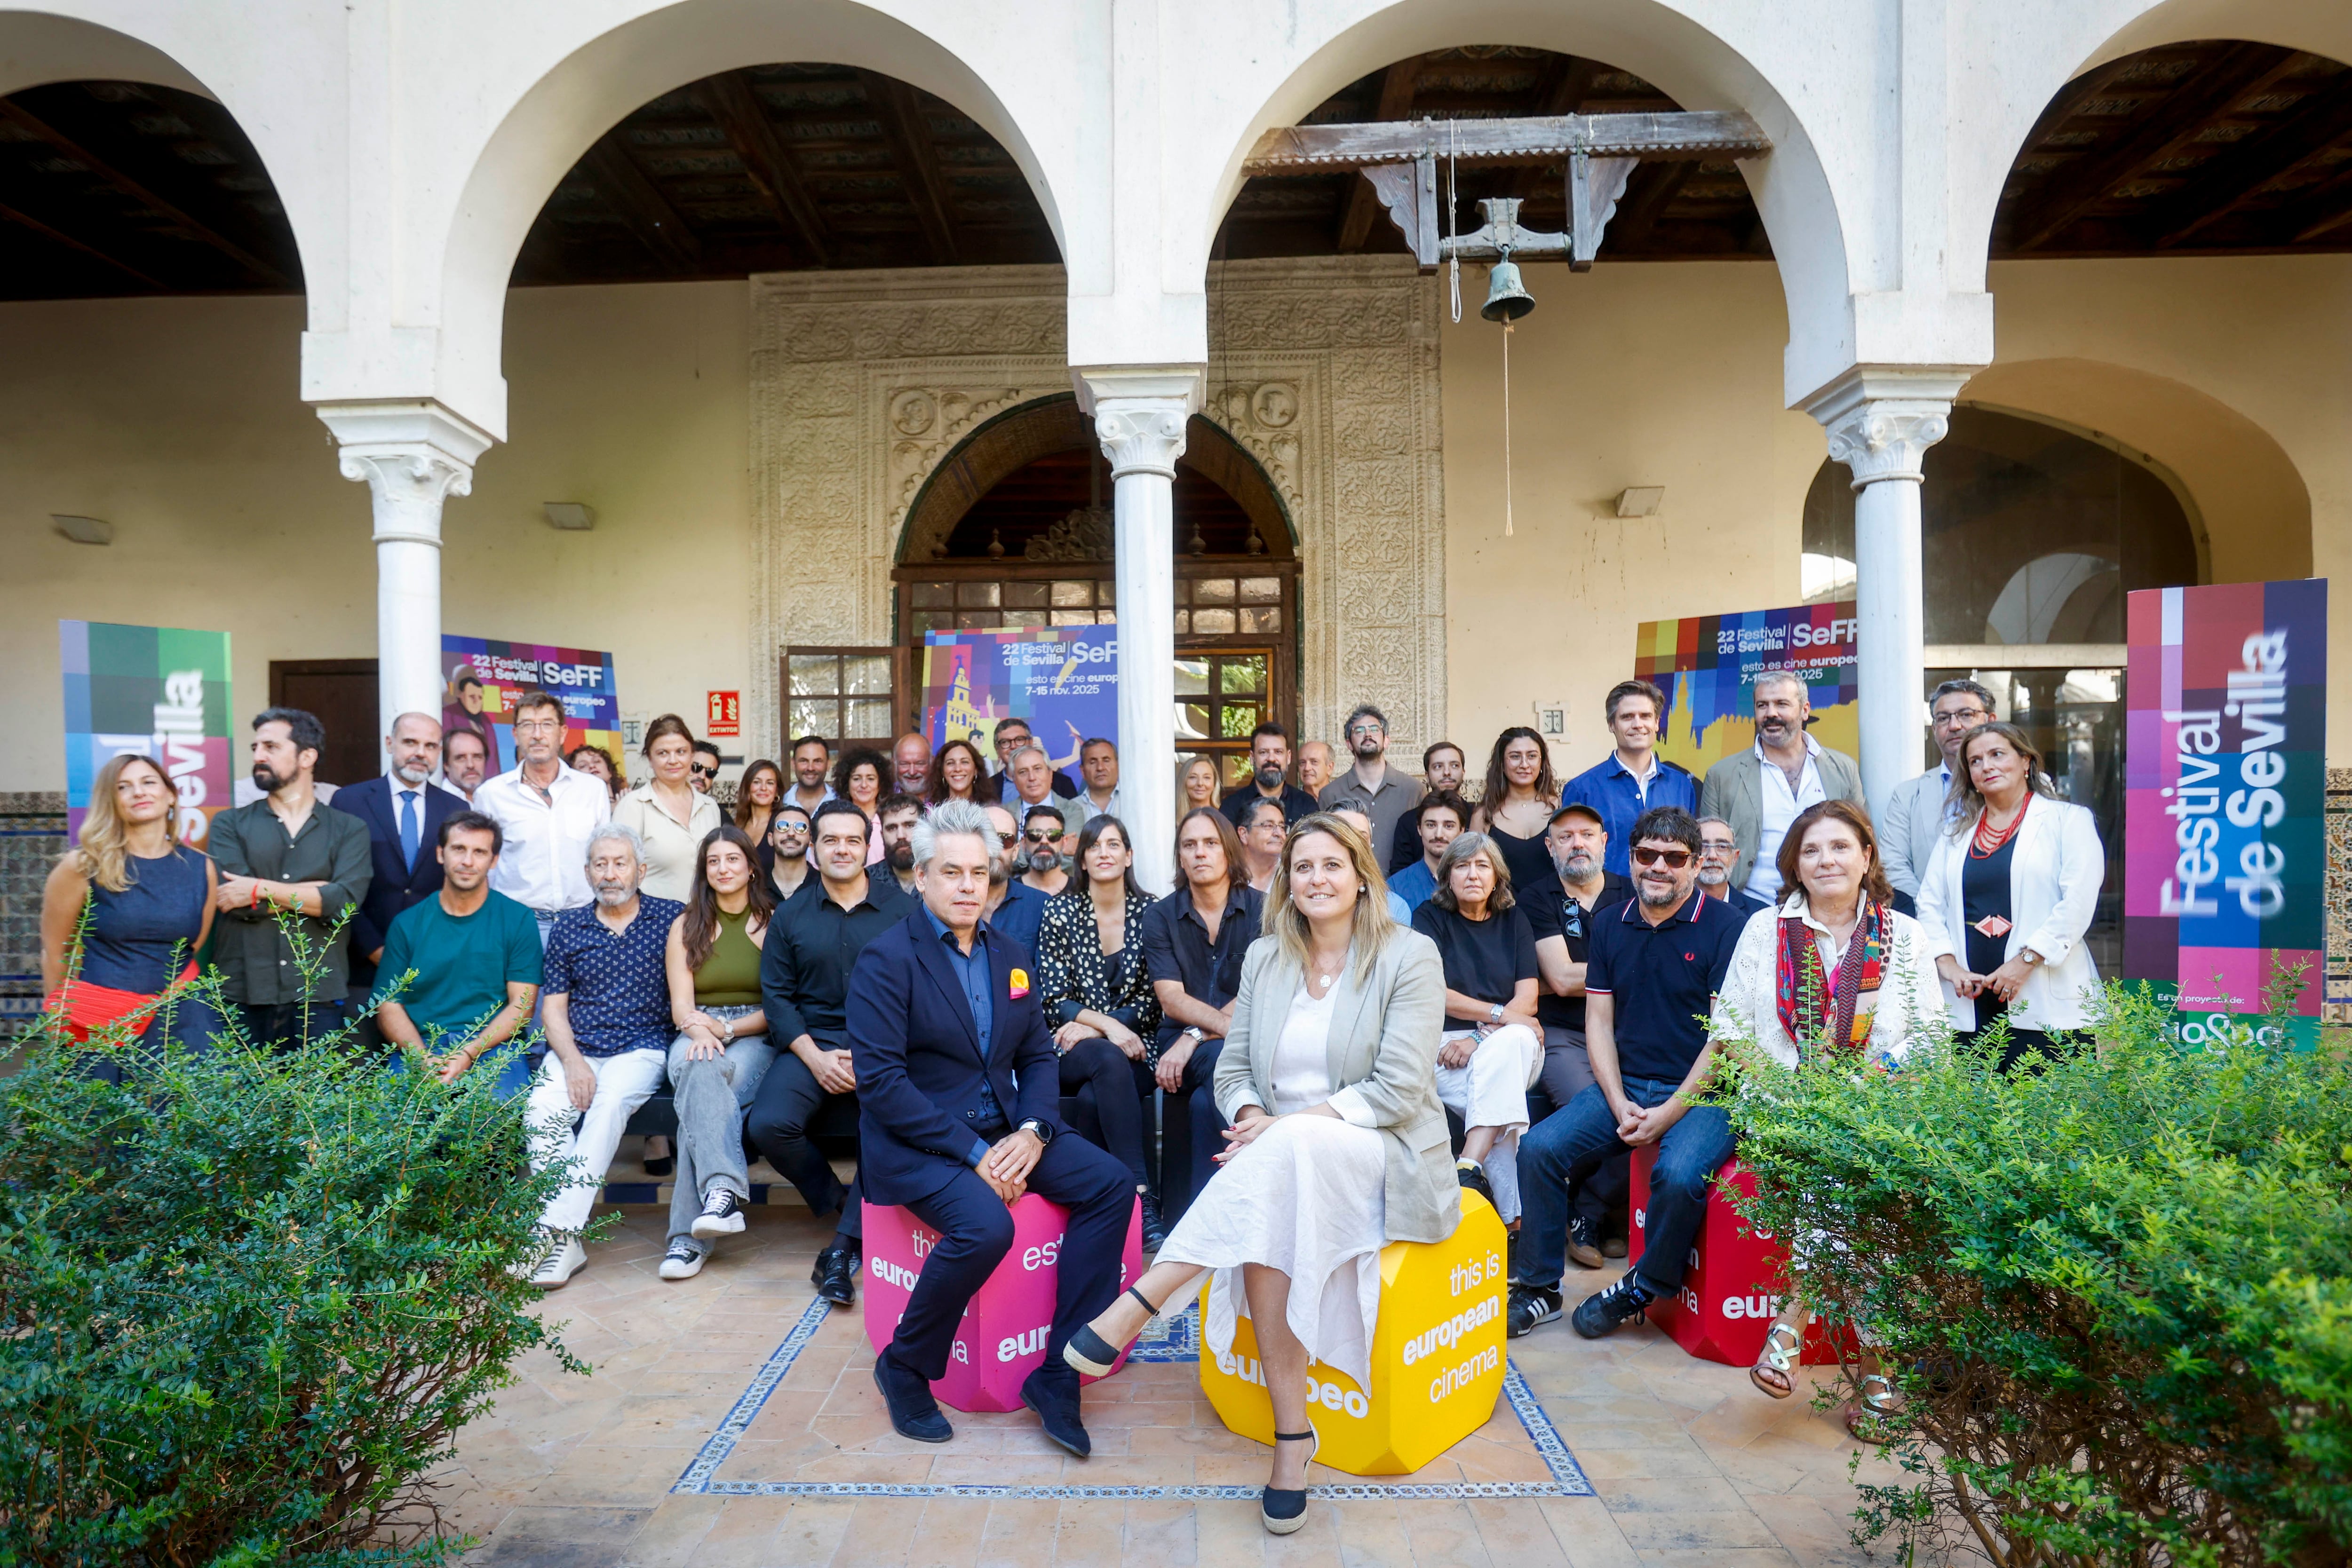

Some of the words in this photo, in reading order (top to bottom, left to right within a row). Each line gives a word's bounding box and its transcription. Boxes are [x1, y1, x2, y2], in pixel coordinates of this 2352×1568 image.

[1717, 630, 1735, 643] 22
[1737, 625, 1786, 641] Festival
[1002, 644, 1019, 655] 22
[1021, 642, 1066, 654] Festival
[1072, 641, 1118, 664] SeF
[1718, 642, 1734, 655] de
[1738, 639, 1784, 653] Sevilla
[472, 654, 491, 666] 22
[492, 656, 538, 672] Festival
[1003, 656, 1019, 666] de
[1022, 653, 1064, 665] Sevilla
[1742, 660, 1765, 672] esto
[1768, 661, 1781, 670] es
[1784, 658, 1807, 669] cine
[476, 667, 493, 679] de
[494, 668, 538, 682] Sevilla
[543, 662, 602, 687] SeFF
[1025, 675, 1048, 684] esto
[1065, 673, 1085, 683] cine
[1087, 674, 1118, 684] europ
[1741, 673, 1761, 685] 7-1
[1025, 686, 1048, 696] 7-15
[1072, 685, 1100, 695] 2025
[562, 695, 606, 707] europeo
[2225, 628, 2288, 829] Sevilla
[2160, 709, 2221, 918] Festival
[2225, 840, 2285, 920] de
[871, 1256, 920, 1292] euro
[1450, 1258, 1482, 1297] this
[1486, 1249, 1499, 1279] is
[1403, 1295, 1499, 1366] european
[1430, 1345, 1498, 1403] cinema
